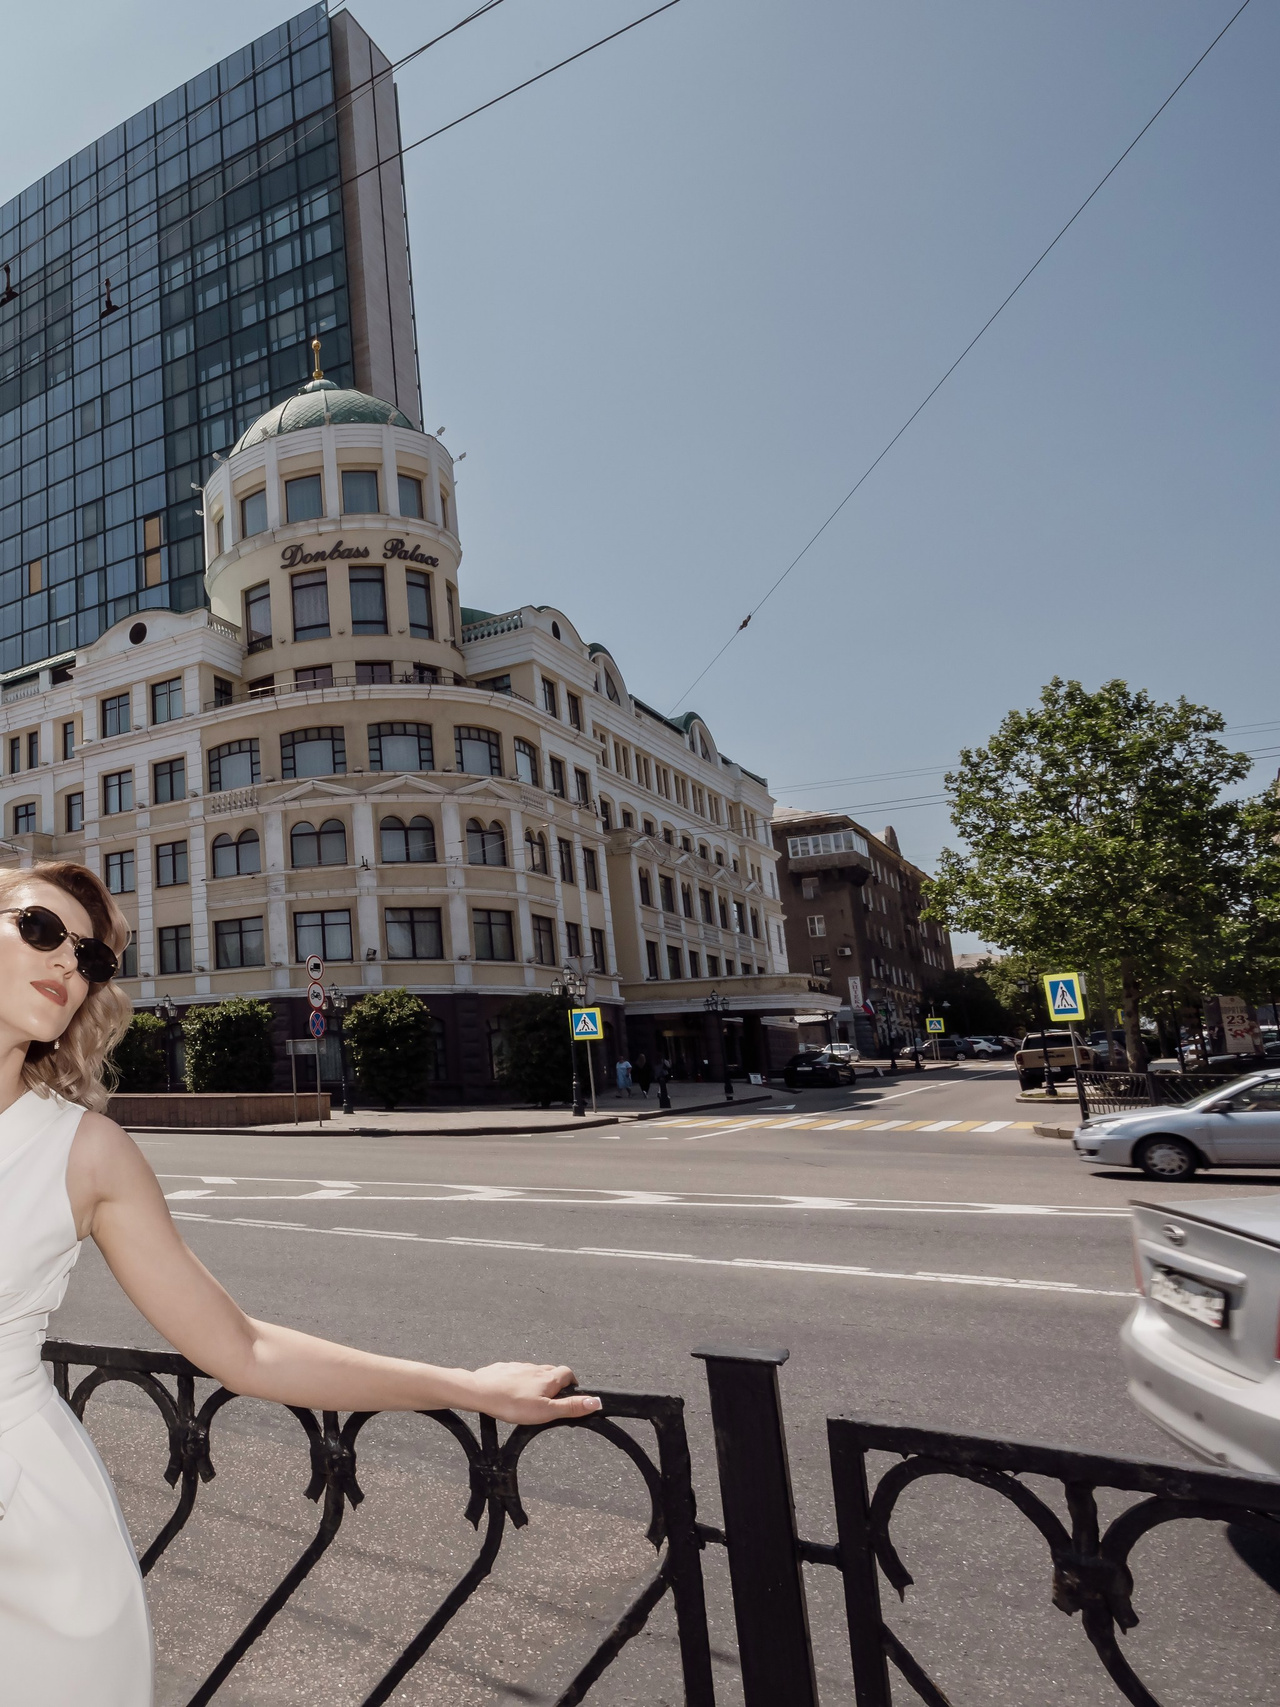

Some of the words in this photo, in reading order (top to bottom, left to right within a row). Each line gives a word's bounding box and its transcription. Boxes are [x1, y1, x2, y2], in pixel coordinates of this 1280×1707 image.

[280, 540, 369, 569] Donbass
[382, 538, 439, 567] Palace
[1226, 1015, 1246, 1025] 23
